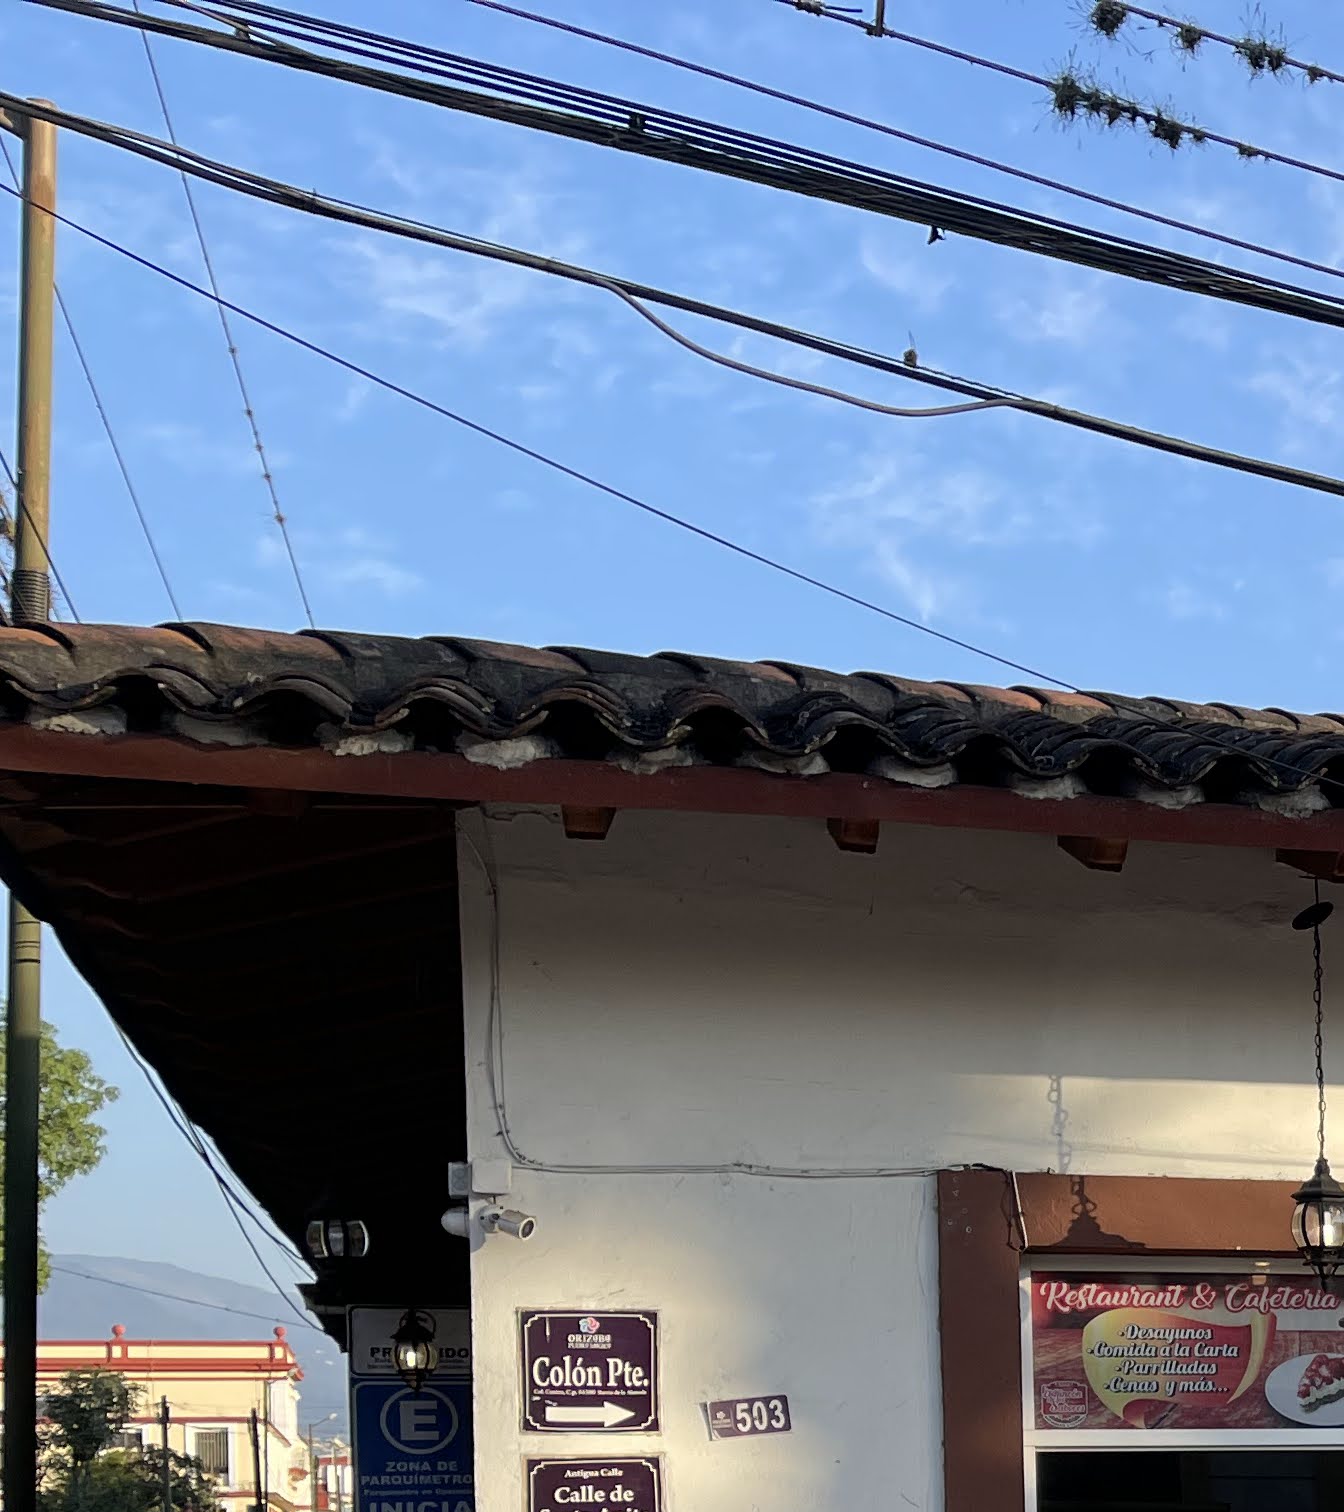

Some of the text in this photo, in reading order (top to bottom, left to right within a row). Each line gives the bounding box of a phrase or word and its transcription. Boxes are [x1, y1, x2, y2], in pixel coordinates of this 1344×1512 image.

[1040, 1280, 1184, 1313] Restaurant
[1191, 1283, 1218, 1310] &
[1125, 1323, 1214, 1344] Desayunos
[1093, 1341, 1240, 1357] Comida a la Carta
[532, 1355, 649, 1387] Colón Pte.
[1121, 1359, 1218, 1375] Parrilladas
[1109, 1376, 1159, 1392] Cenas
[1165, 1380, 1177, 1397] y
[400, 1400, 440, 1440] E
[735, 1399, 785, 1432] 503
[385, 1461, 459, 1472] ZONA DE
[564, 1468, 623, 1479] Antigua Calle
[554, 1484, 635, 1503] Calle de
